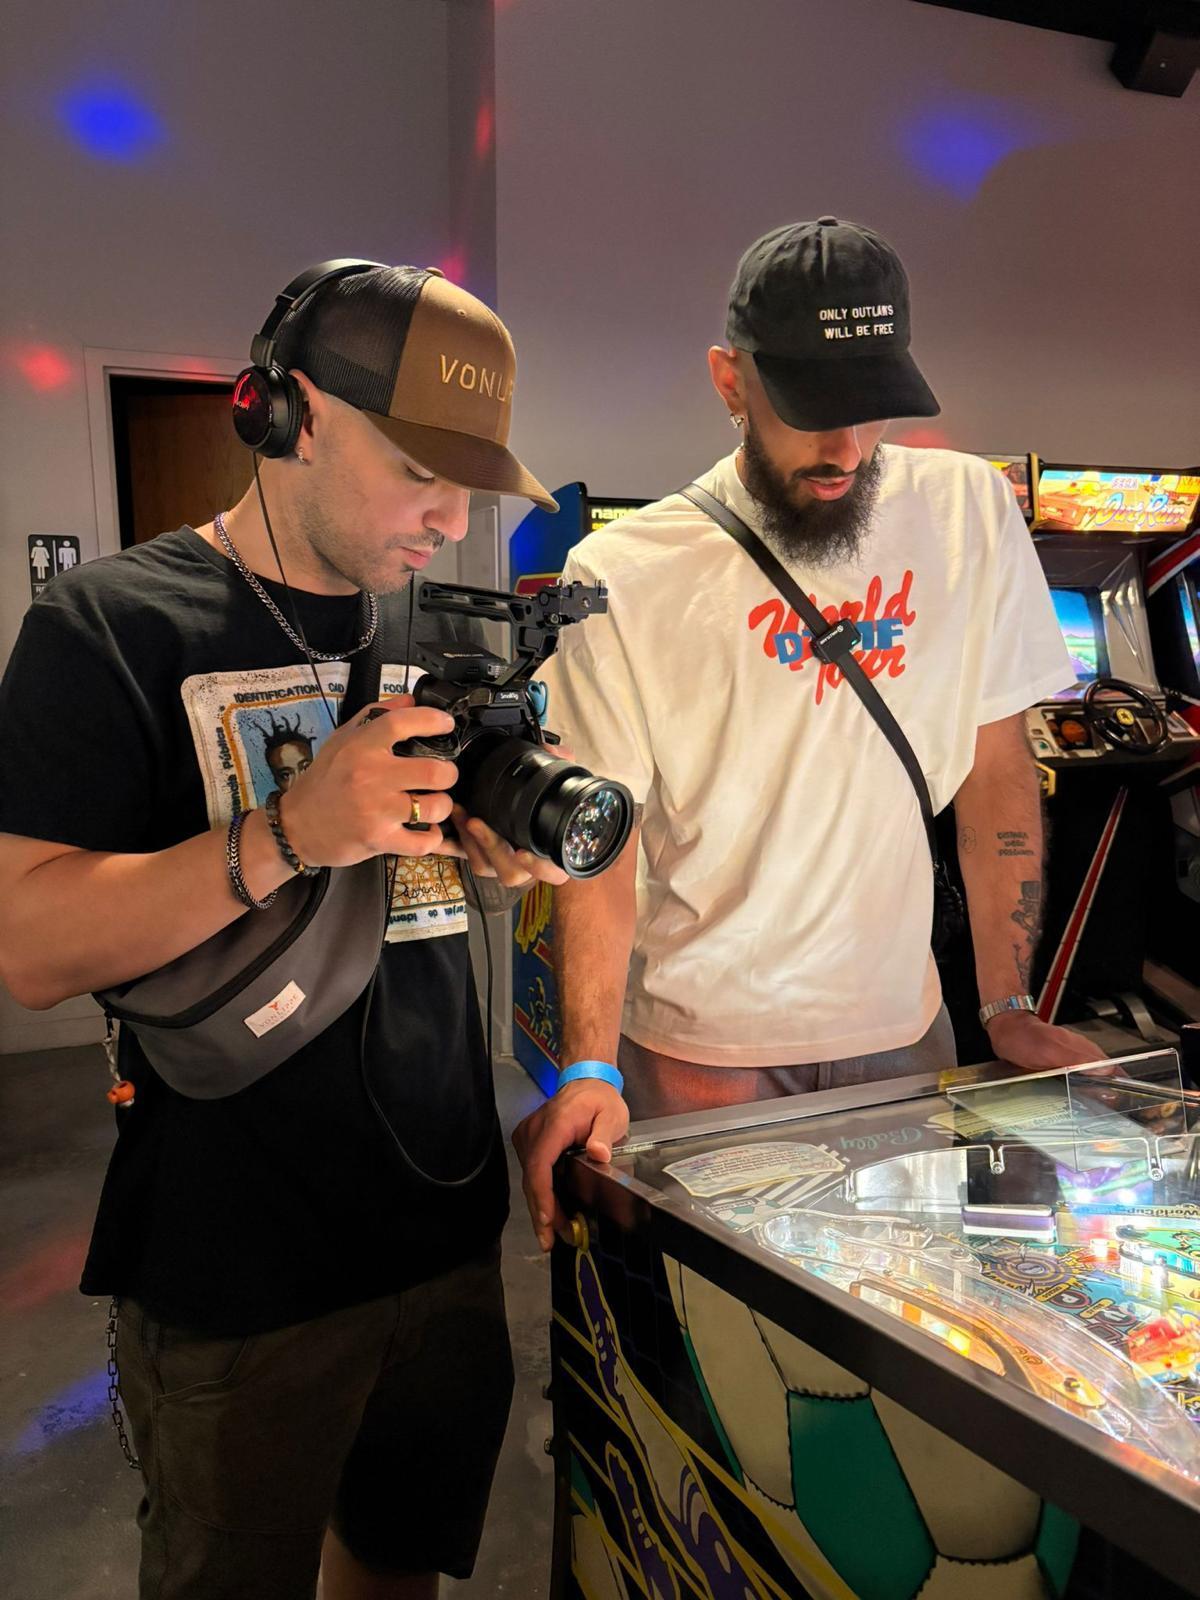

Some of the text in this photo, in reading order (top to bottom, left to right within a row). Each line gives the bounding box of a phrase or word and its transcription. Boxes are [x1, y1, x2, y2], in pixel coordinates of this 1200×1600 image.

[820, 305, 894, 320] ONLY OUTLAWS
[824, 323, 894, 339] WILL BE FREE
[440, 354, 513, 402] VONL
[1112, 478, 1138, 489] SEGA
[233, 684, 320, 703] IDENTIFICATION
[840, 1127, 922, 1150] Bally
